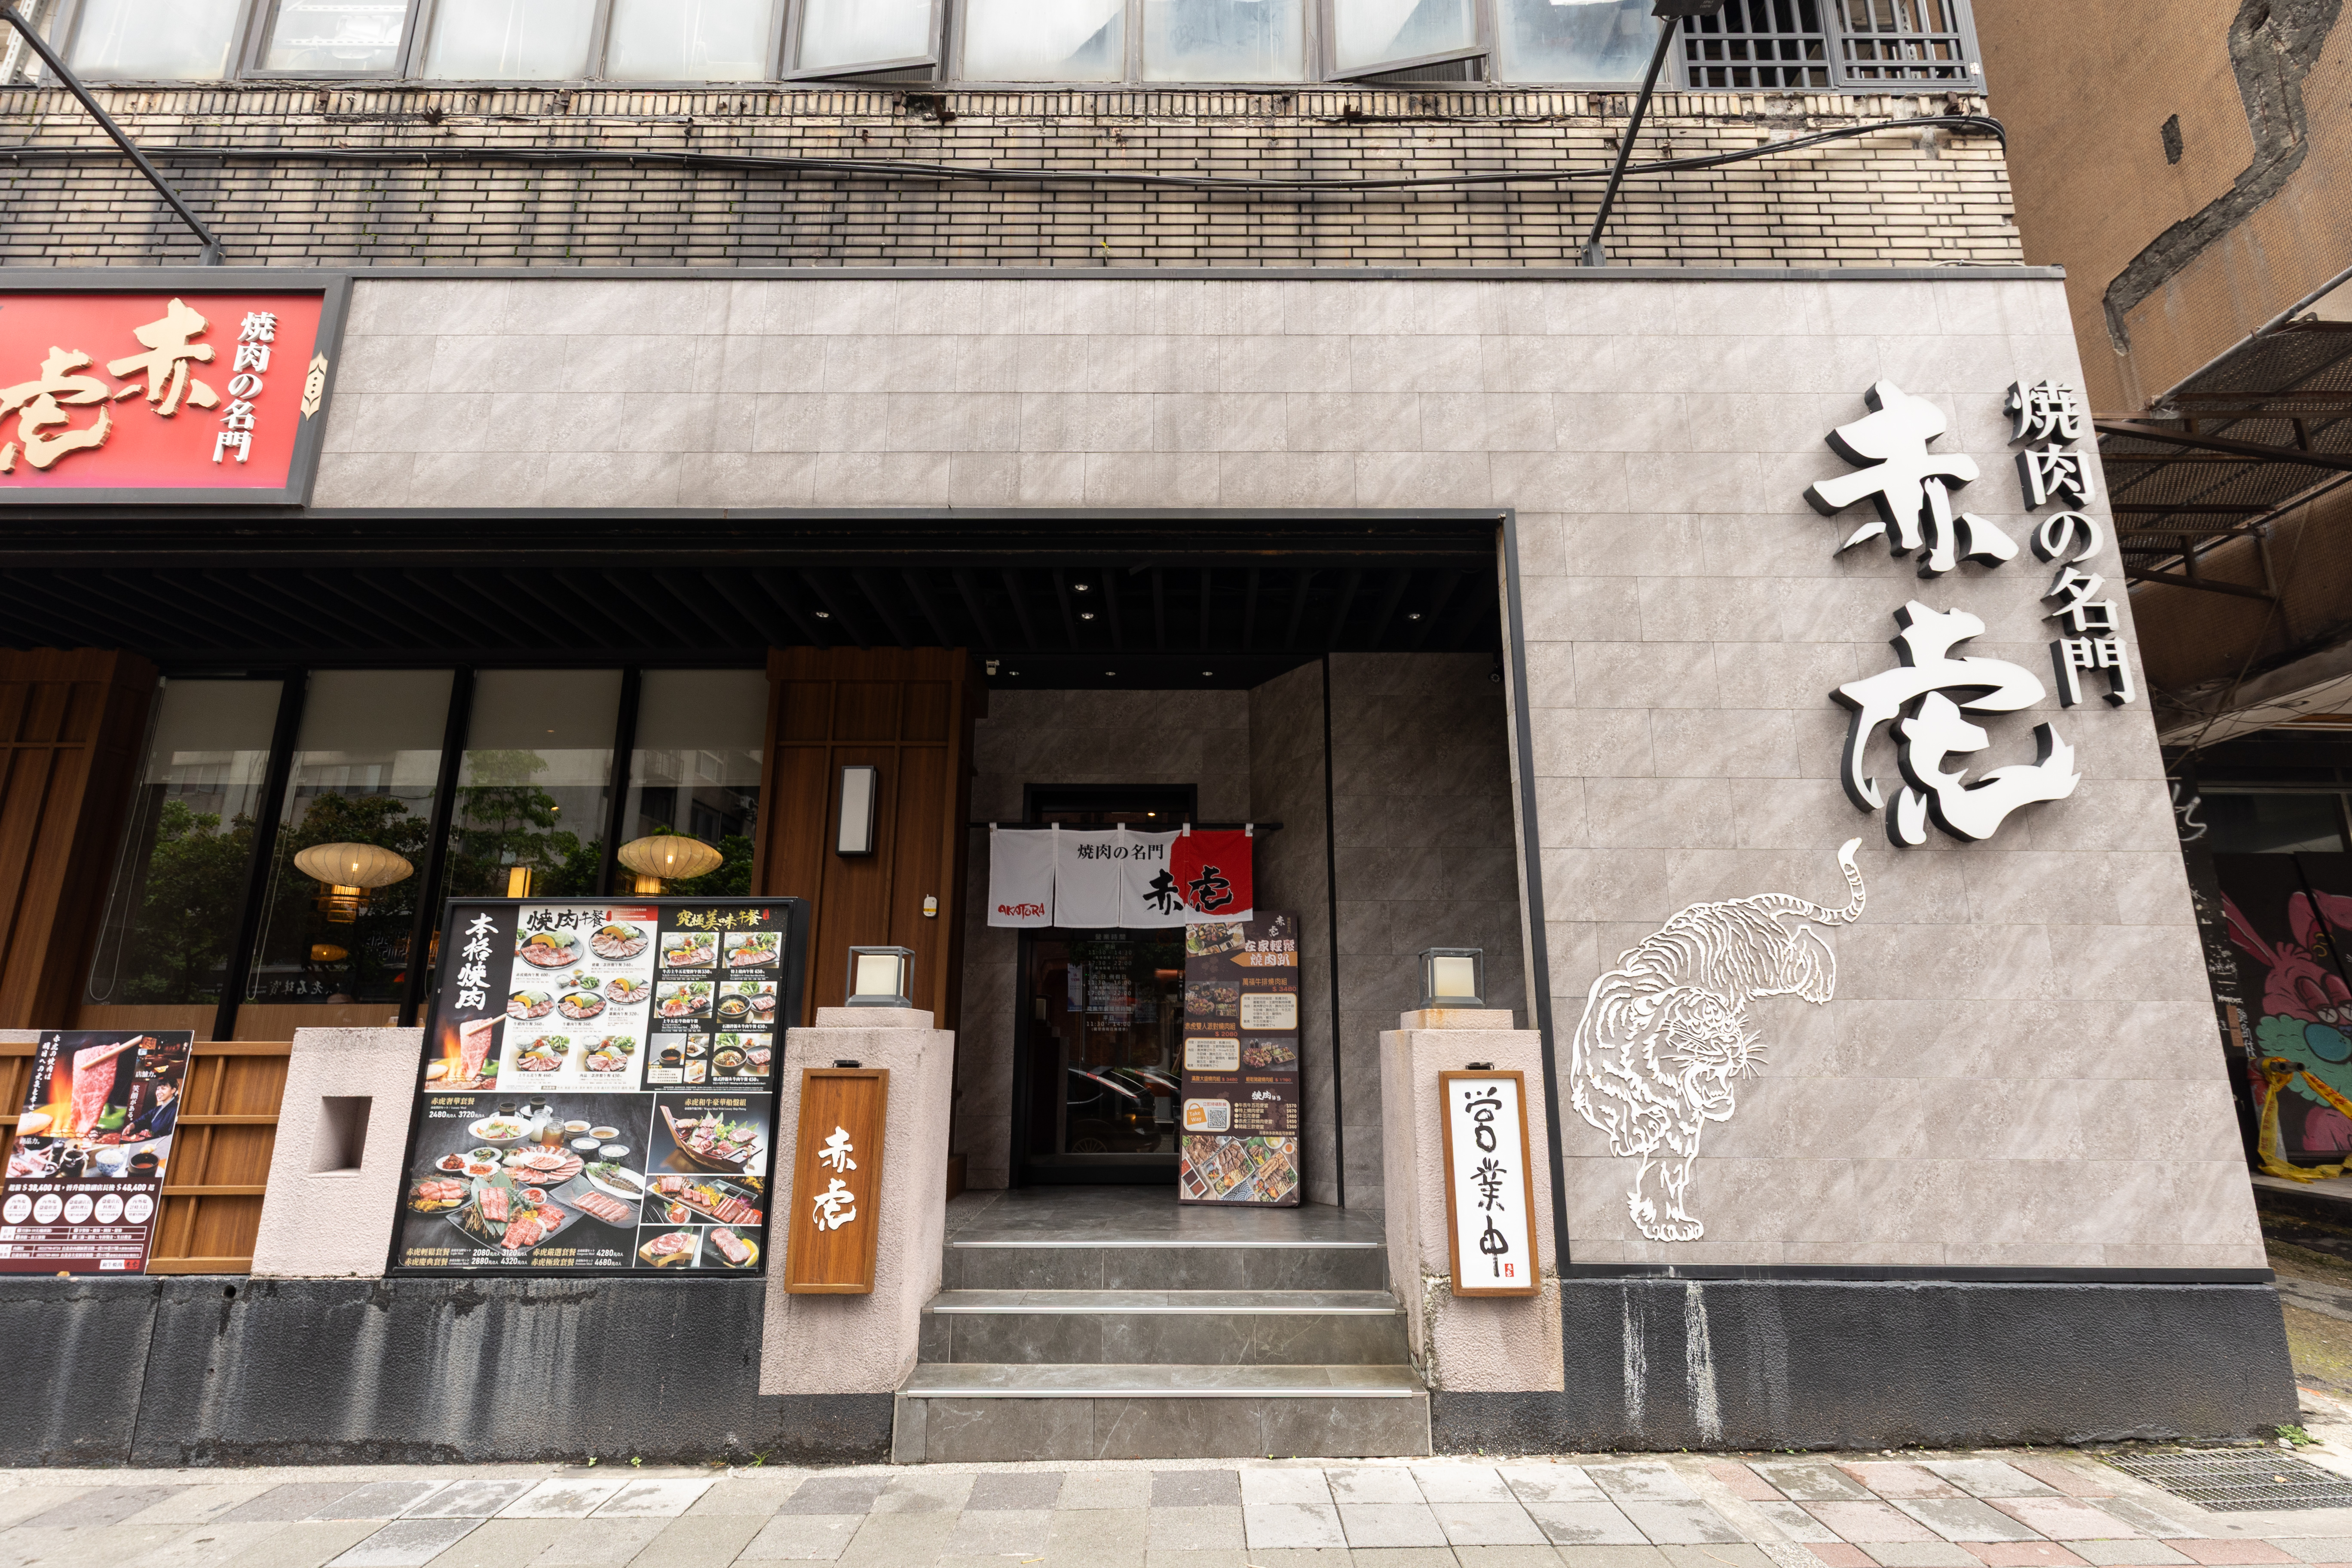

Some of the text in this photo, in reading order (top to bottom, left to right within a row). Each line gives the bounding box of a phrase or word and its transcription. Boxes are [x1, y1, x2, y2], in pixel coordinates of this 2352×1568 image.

[212, 311, 277, 464] 焼肉の名門
[2003, 380, 2135, 708] 焼肉の名門
[1804, 379, 2082, 848] 赤虎
[1077, 843, 1164, 861] 焼肉の名門
[1143, 865, 1234, 916] 赤虎
[998, 902, 1046, 918] AKATORA
[676, 909, 763, 931] 究極美味午餐
[1268, 915, 1286, 937] 赤虎
[1245, 939, 1295, 952] 在家輕鬆
[1250, 953, 1290, 966] 燒肉趴
[1242, 977, 1287, 986] 萬福牛排燒肉組
[1185, 1022, 1236, 1030] 赤虎雙人派對燒肉組
[431, 1097, 475, 1105] 赤虎奢華套餐
[814, 1126, 857, 1231] 赤虎
[28, 1183, 52, 1192] 38,400
[122, 1184, 147, 1192] 48,400
[406, 1248, 450, 1256] 赤虎輕鬆套餐
[533, 1248, 577, 1257] 赤虎嚴選套餐
[531, 1258, 575, 1267] 赤虎極致套餐
